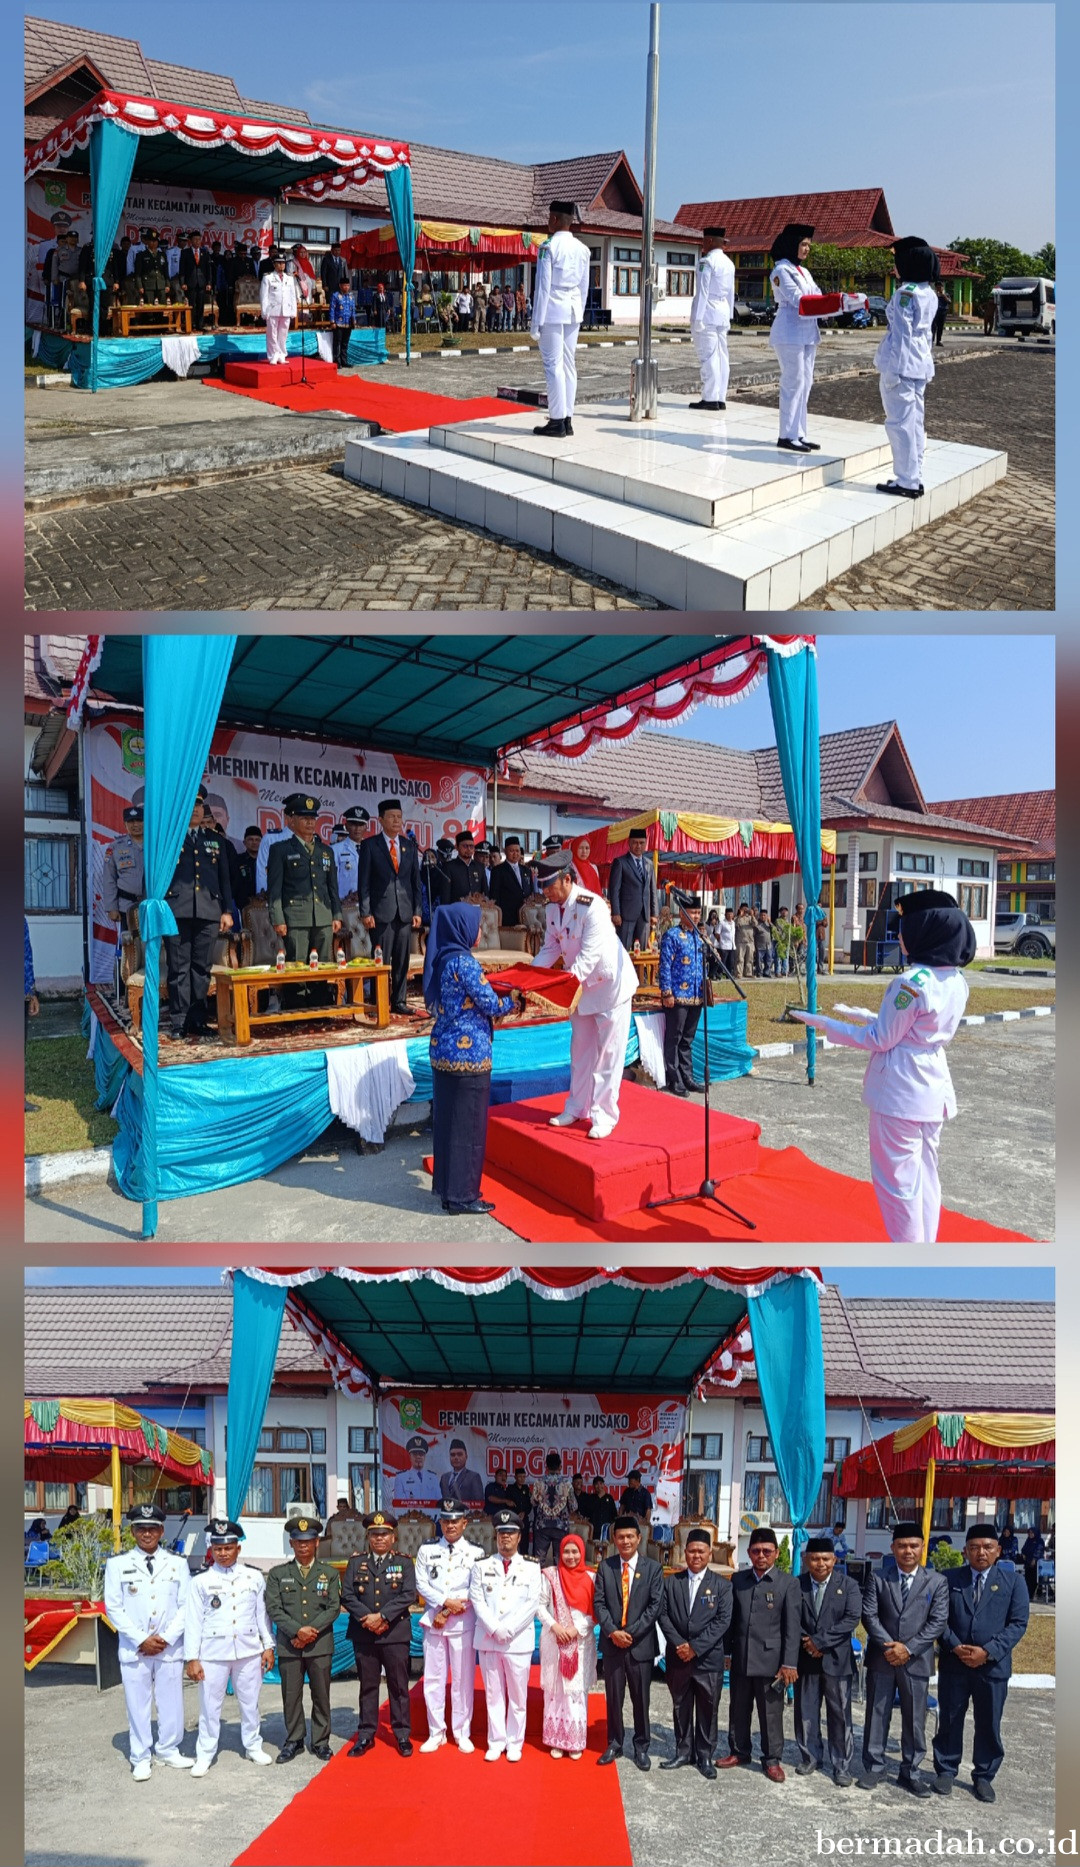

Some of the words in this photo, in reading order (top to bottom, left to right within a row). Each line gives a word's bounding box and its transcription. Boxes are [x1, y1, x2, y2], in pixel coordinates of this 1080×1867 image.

[147, 198, 200, 214] KECAMATAN
[202, 204, 236, 216] PUSAKO
[204, 755, 289, 783] MERINTAH
[293, 764, 377, 793] KECAMATAN
[381, 777, 431, 799] PUSAKO
[439, 1411, 511, 1427] PEMERINTAH
[514, 1412, 580, 1428] KECAMATAN
[584, 1413, 629, 1429] PUSAKO
[487, 1432, 545, 1444] Mengucapkan
[487, 1447, 629, 1477] DIRGHAYU
